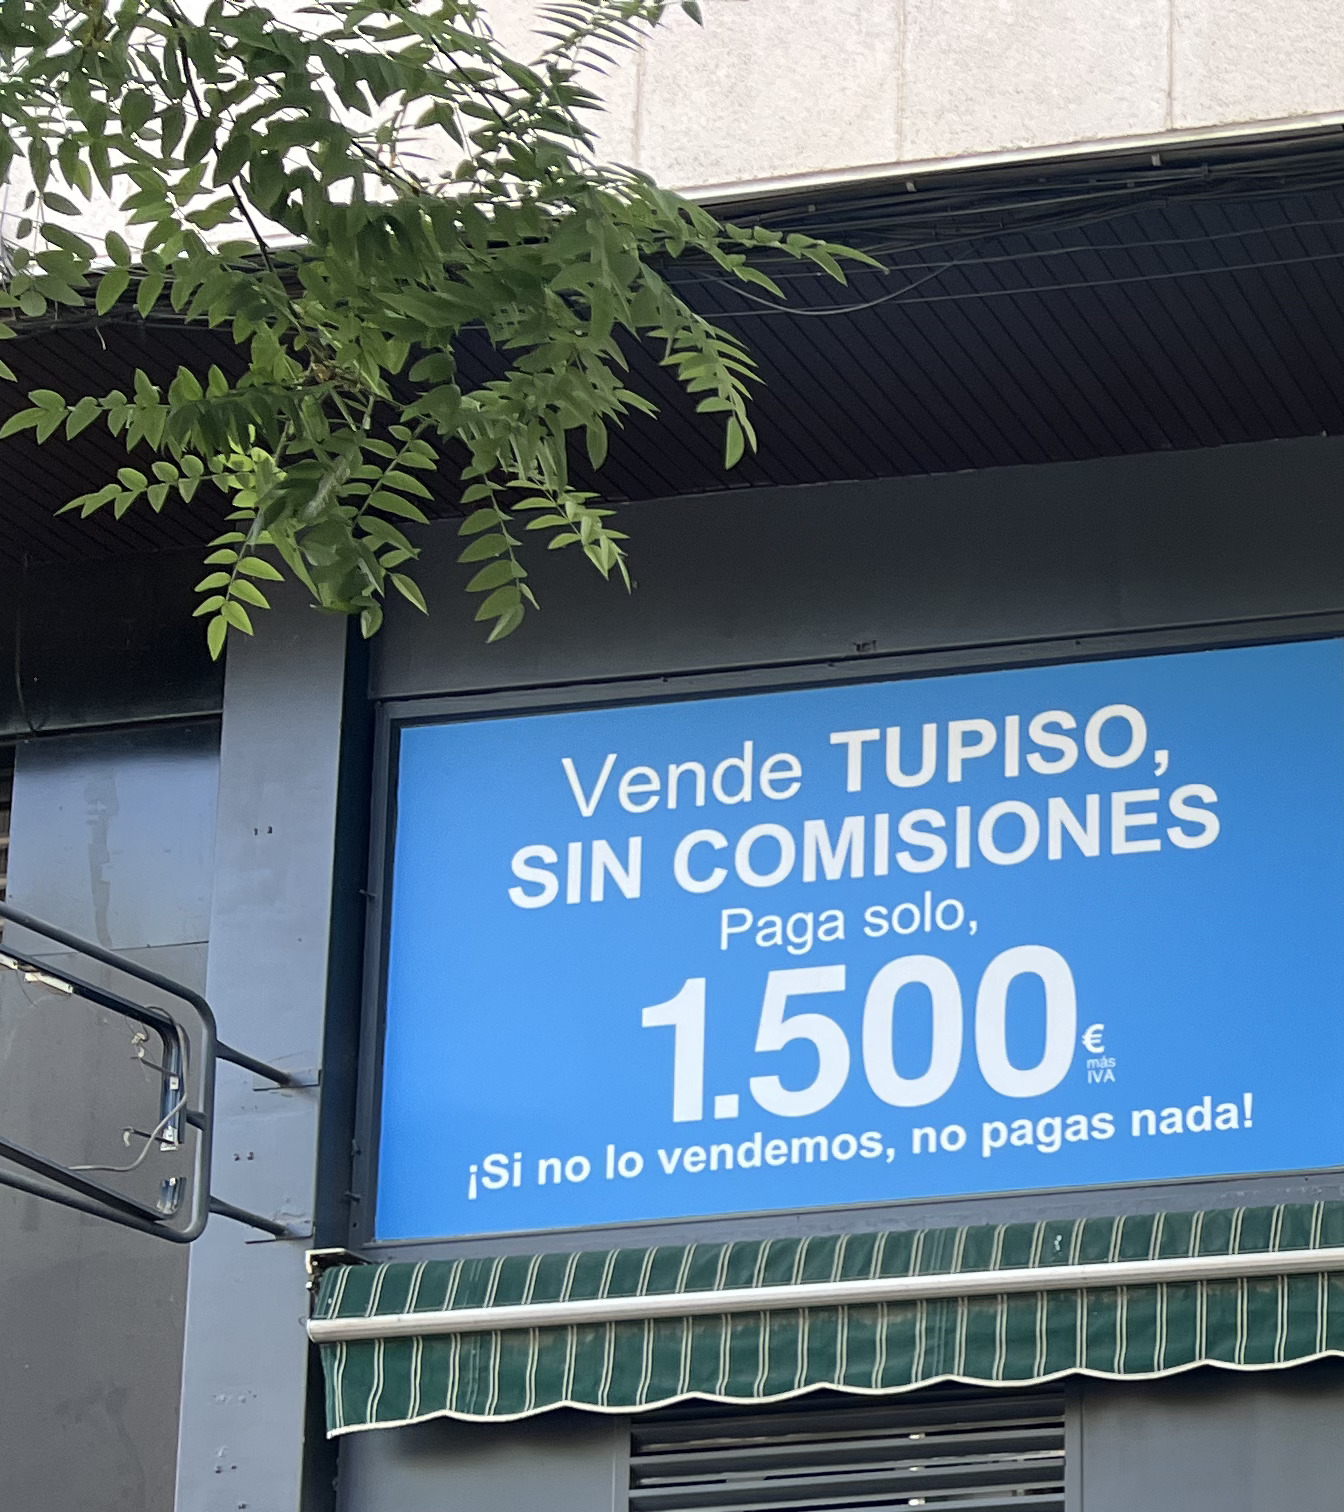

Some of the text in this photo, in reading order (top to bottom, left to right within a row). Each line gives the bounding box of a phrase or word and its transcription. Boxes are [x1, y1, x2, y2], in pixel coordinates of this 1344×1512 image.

[561, 704, 1171, 818] Vende TUPISO,
[508, 784, 1221, 910] SIN COMISIONES
[719, 891, 979, 952] Paga solo,
[640, 944, 1105, 1124] 1.500 €
[1086, 1055, 1116, 1069] más
[1087, 1069, 1116, 1084] IVA
[467, 1093, 1254, 1200] ¡Si no lo vendemos, no pagas nada!
